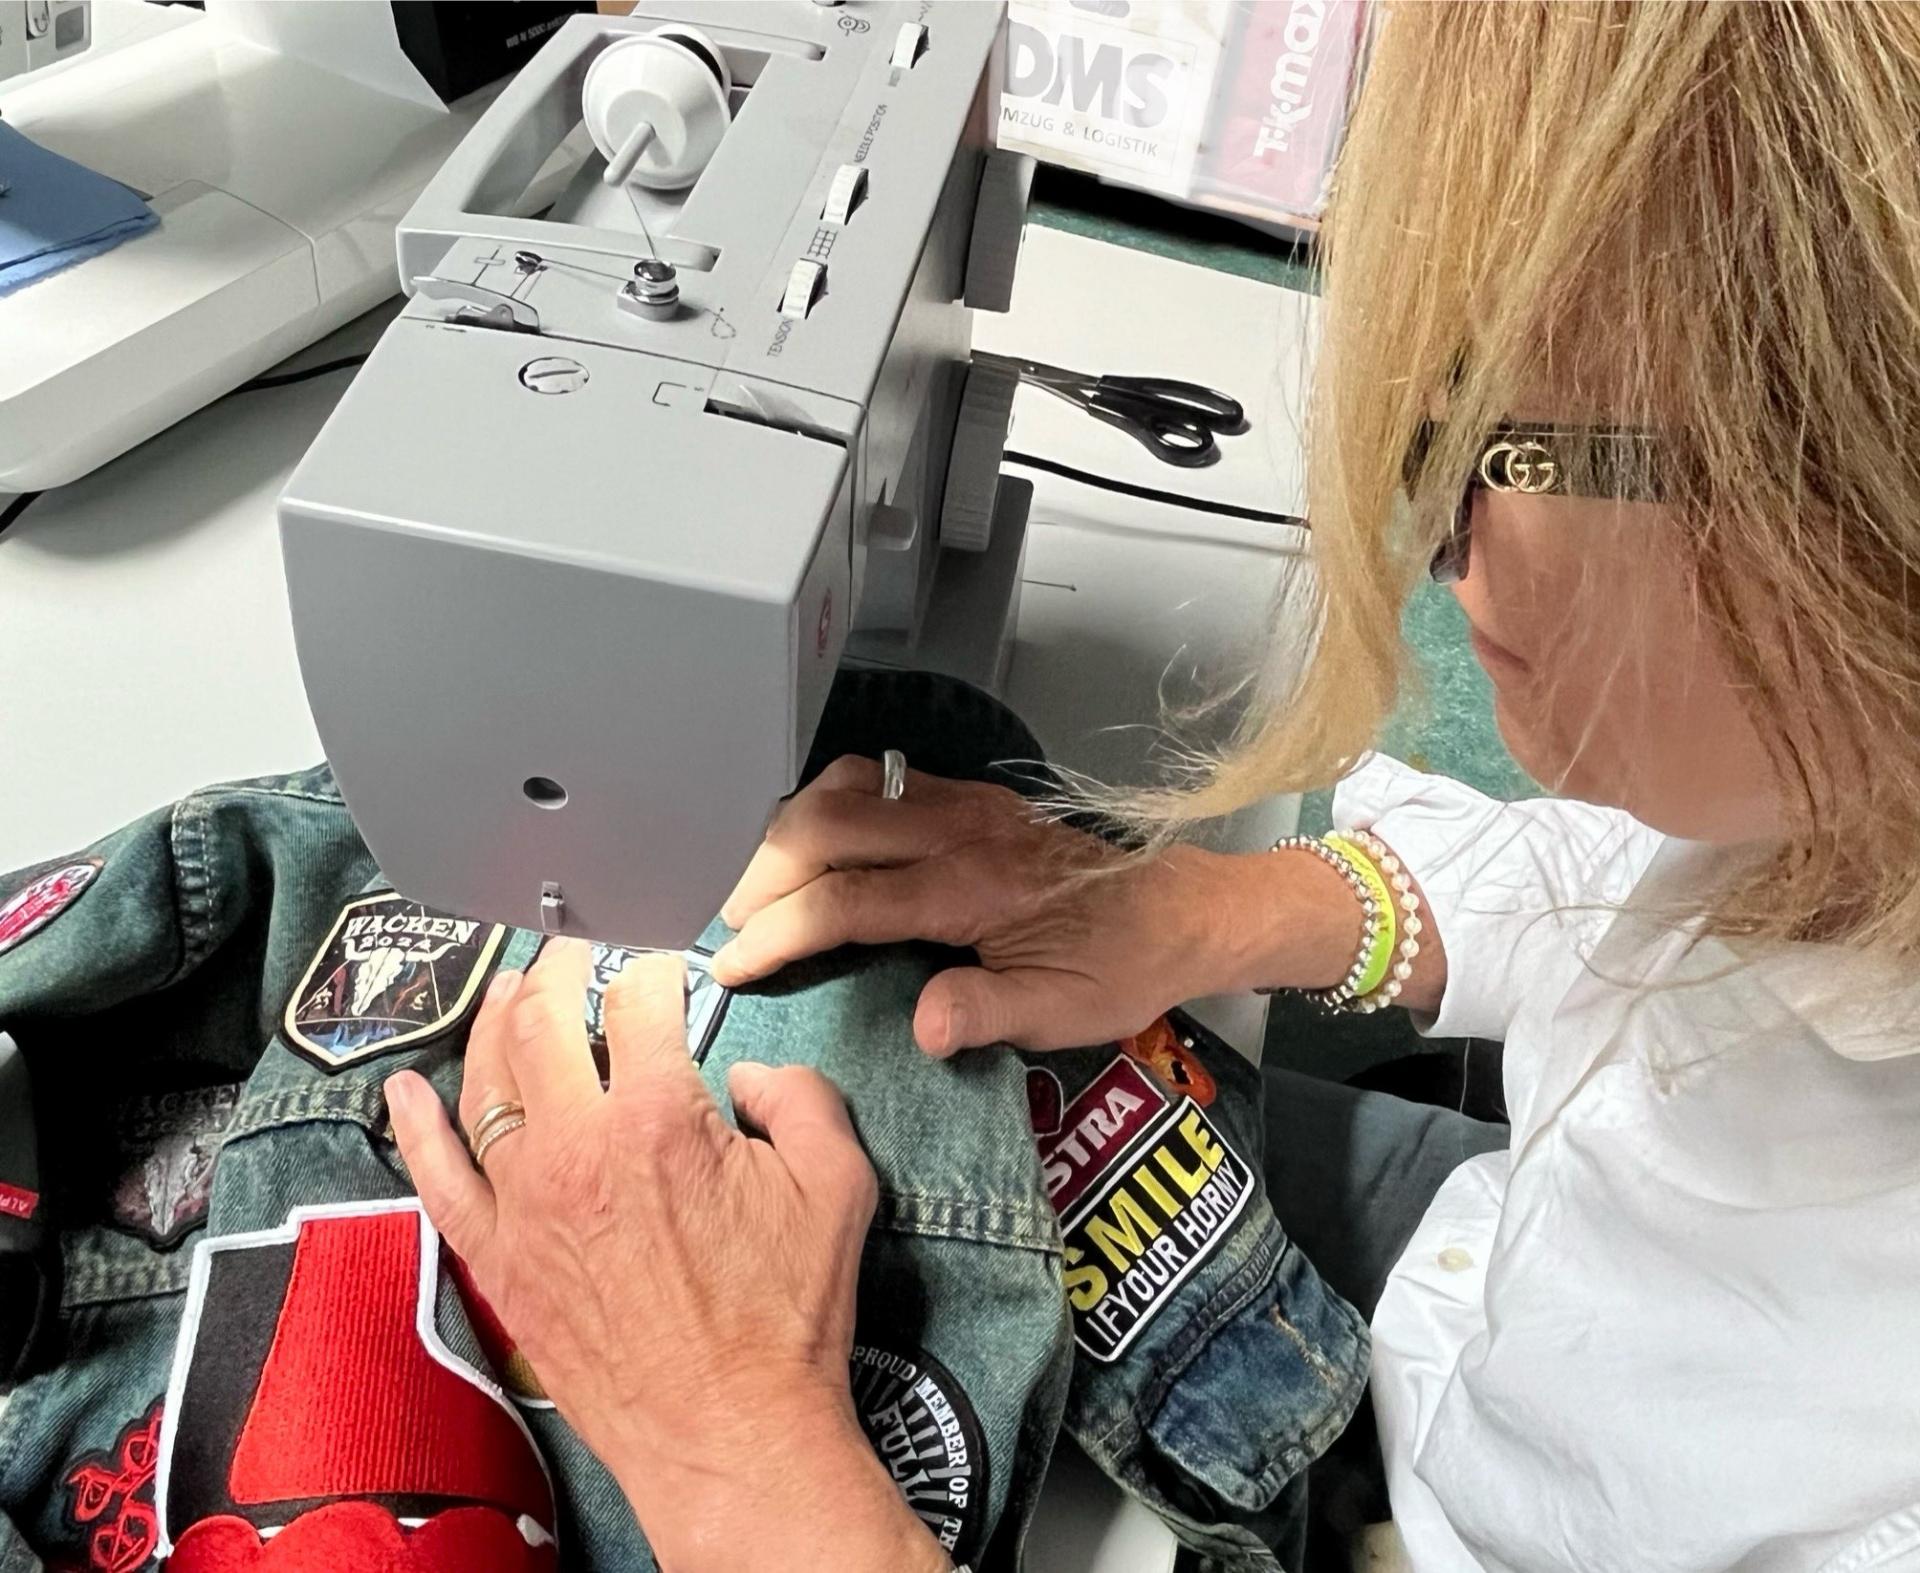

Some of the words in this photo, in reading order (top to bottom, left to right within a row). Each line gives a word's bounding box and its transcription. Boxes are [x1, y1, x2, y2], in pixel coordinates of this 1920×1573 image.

[1003, 19, 1175, 129] DMS
[1000, 106, 1054, 132] MZUG
[1063, 121, 1075, 137] &
[1083, 125, 1158, 158] LOGISTIK
[342, 913, 481, 945] WACKEN
[1063, 1109, 1226, 1311] SMILE
[1174, 1157, 1243, 1249] HORNY
[851, 1346, 917, 1382] PROUD
[914, 1376, 968, 1468] MEMBER
[949, 1477, 969, 1510] OF
